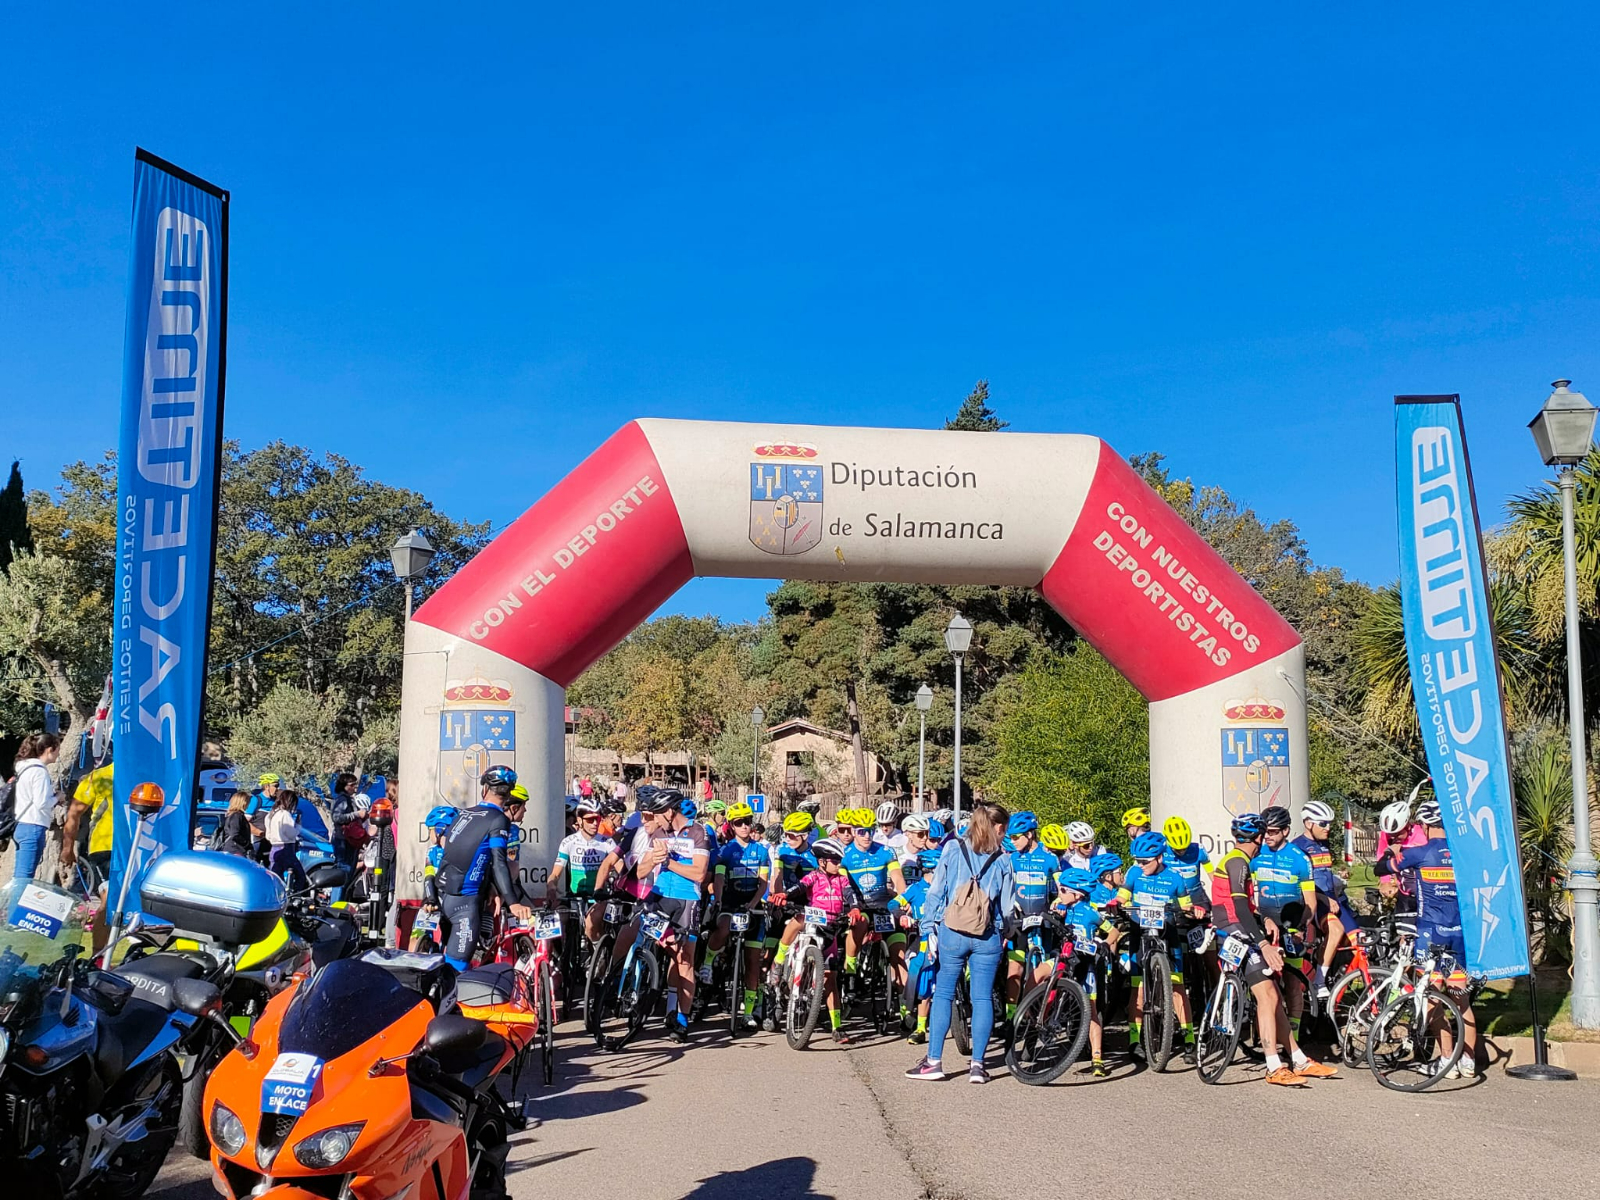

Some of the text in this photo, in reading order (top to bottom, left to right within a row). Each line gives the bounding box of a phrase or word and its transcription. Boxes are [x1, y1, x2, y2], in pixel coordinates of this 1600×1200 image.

[831, 462, 977, 491] Diputación
[829, 513, 1004, 540] de Salamanca
[469, 474, 660, 641] CON EL DEPORTE
[1106, 502, 1261, 654] CON NUESTROS
[1092, 531, 1231, 667] DEPORTISTAS
[572, 855, 602, 863] RURAL
[575, 847, 598, 856] CAJA
[409, 866, 423, 883] de
[25, 912, 52, 927] MOTO
[18, 919, 51, 937] ENLACE
[1227, 941, 1243, 956] 151
[311, 1064, 322, 1079] 1
[274, 1085, 306, 1098] MOTO
[269, 1096, 308, 1110] ENLACE
